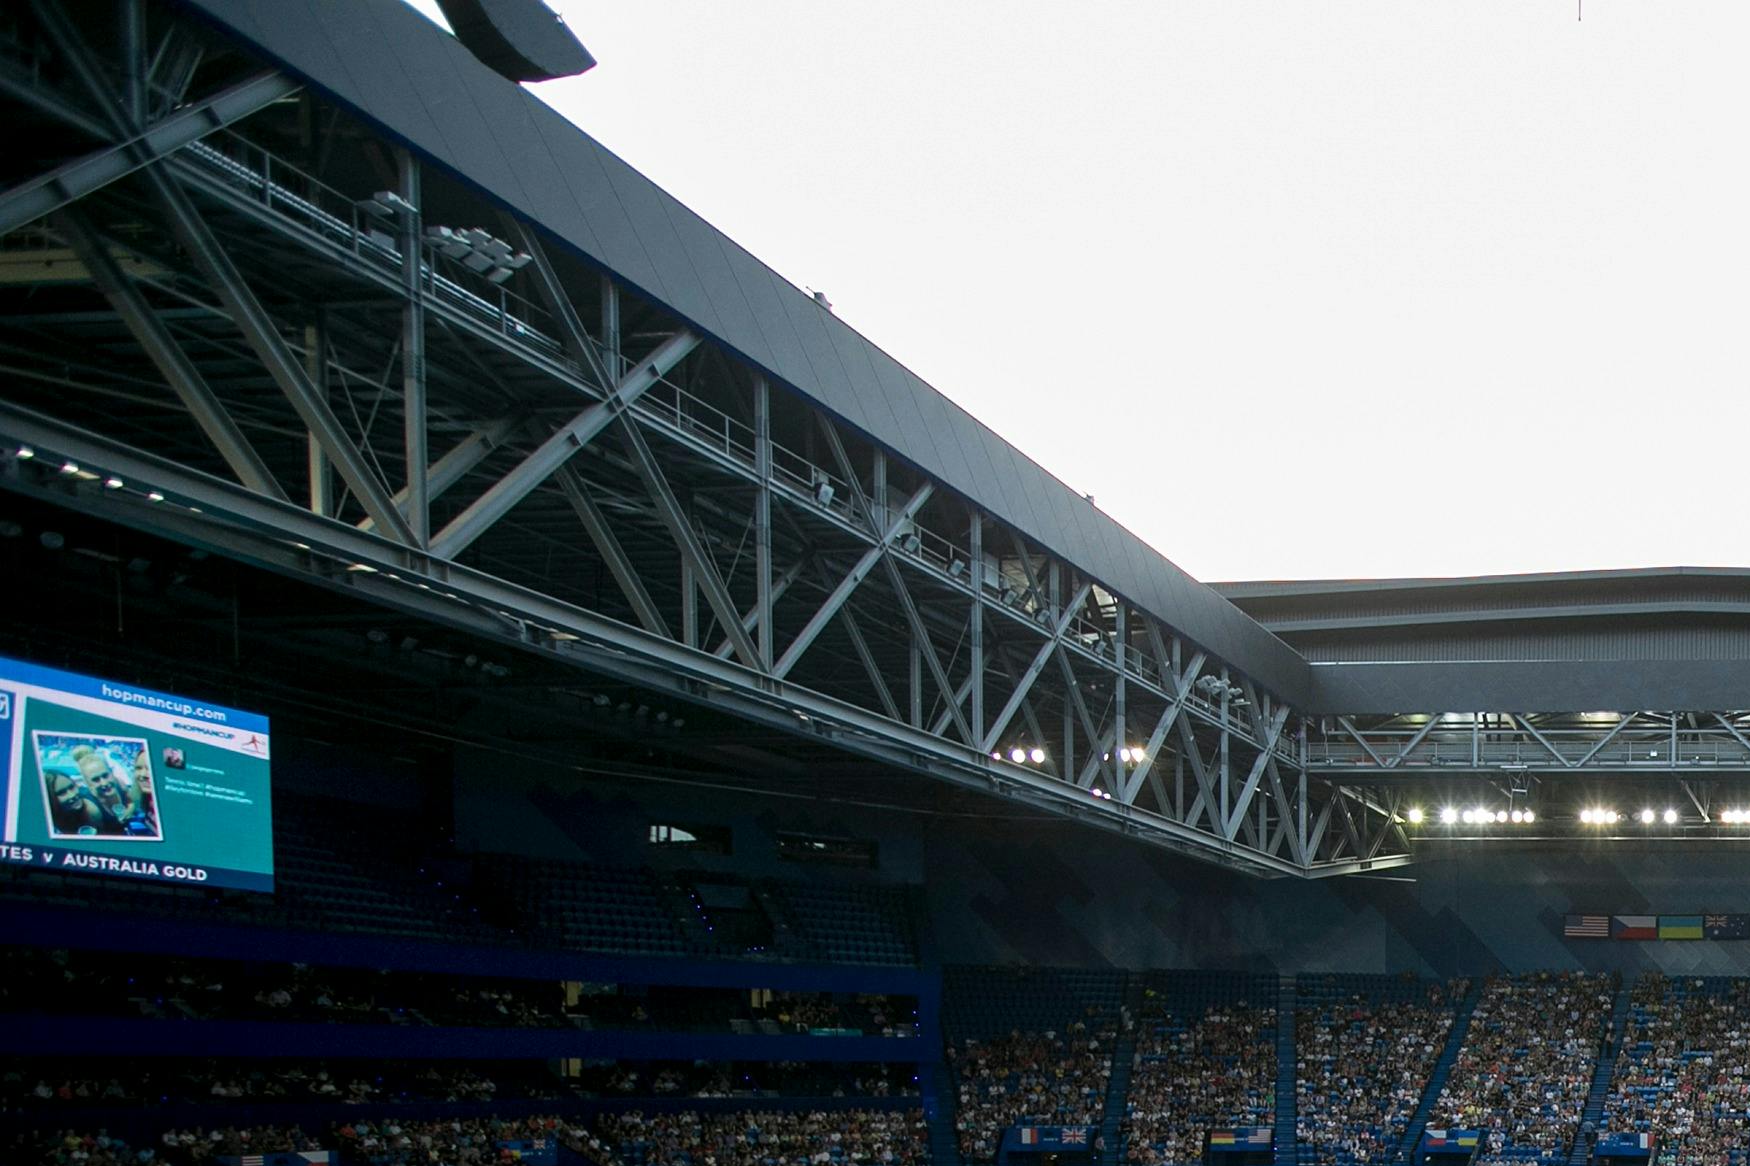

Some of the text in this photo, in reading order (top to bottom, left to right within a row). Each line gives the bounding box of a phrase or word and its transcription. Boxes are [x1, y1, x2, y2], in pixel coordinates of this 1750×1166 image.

[102, 684, 227, 722] hopmancup.com
[173, 722, 235, 739] #HOPMANCUP
[43, 853, 53, 863] v
[63, 853, 159, 876] AUSTRALIA
[162, 866, 207, 881] GOLD
